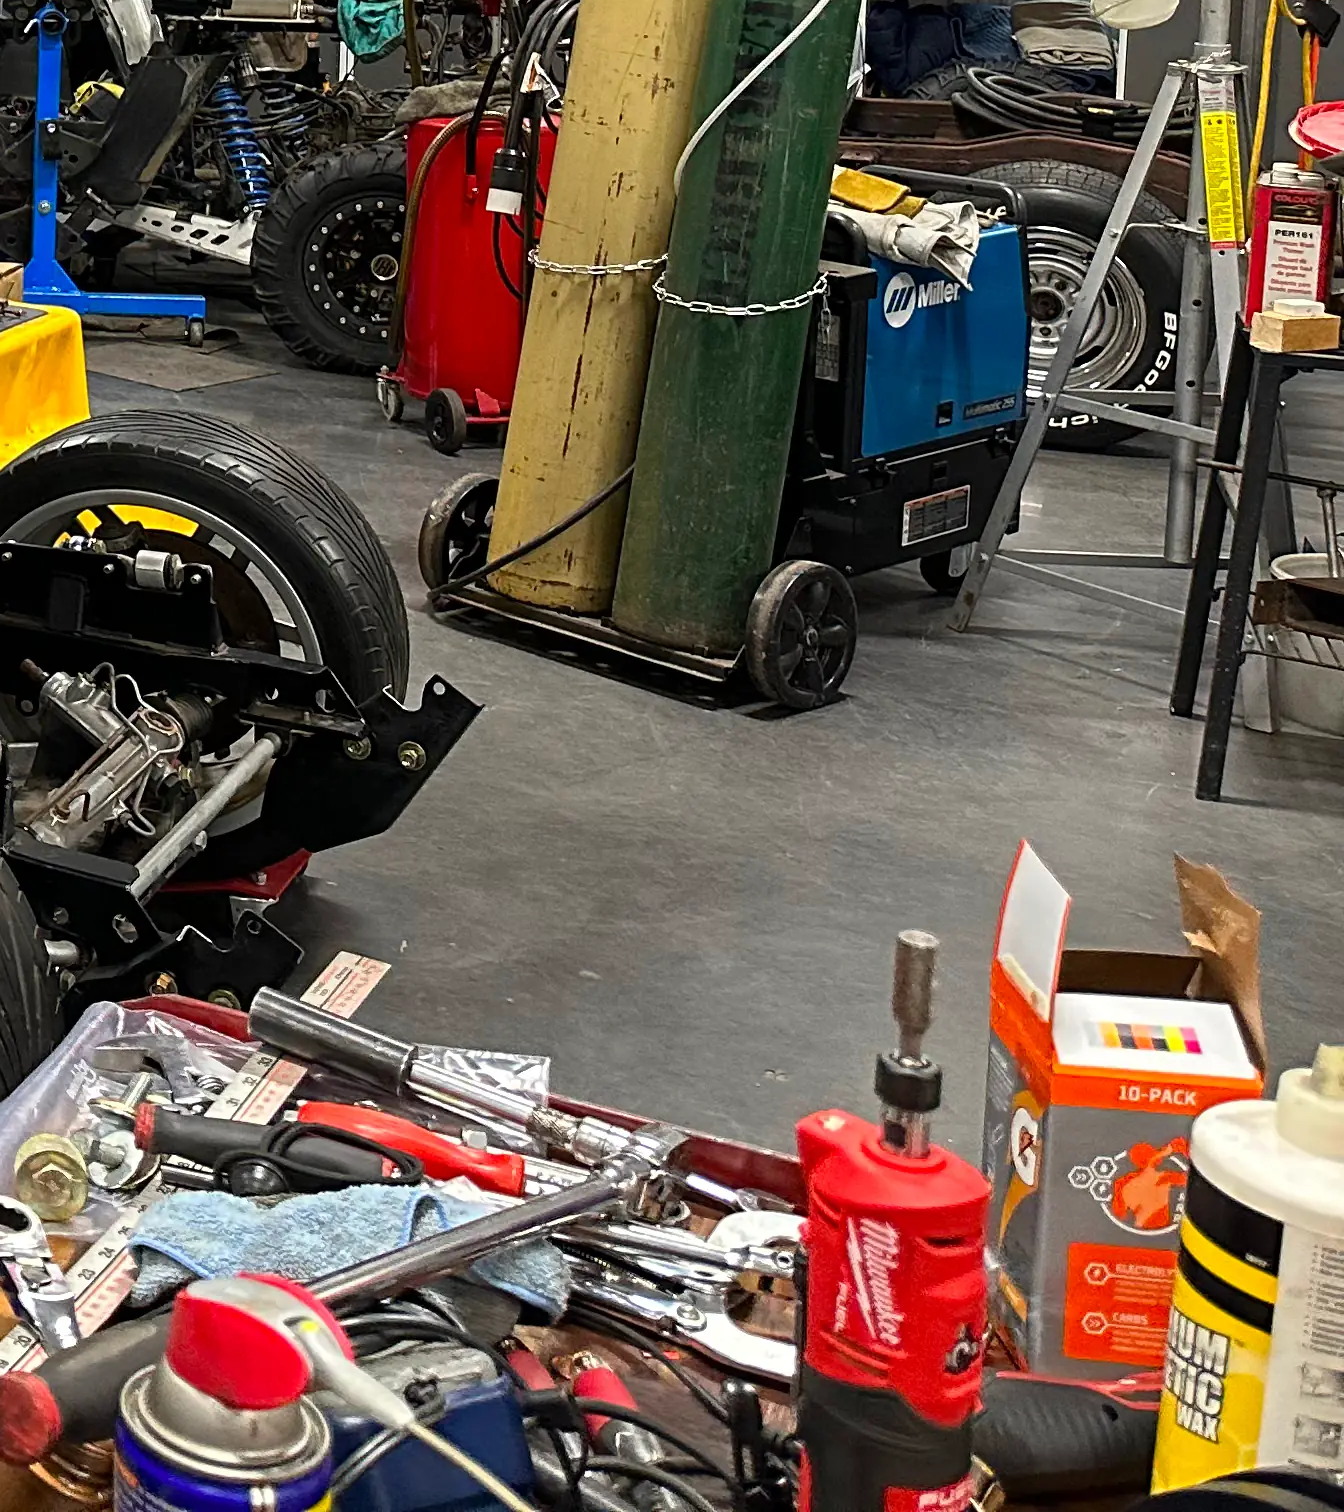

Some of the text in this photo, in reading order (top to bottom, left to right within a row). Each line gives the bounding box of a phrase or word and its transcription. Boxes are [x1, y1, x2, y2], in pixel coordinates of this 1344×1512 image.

[917, 278, 961, 309] Miller
[1118, 1085, 1198, 1106] 10-PACK
[98, 1246, 116, 1260] 24
[78, 1267, 96, 1282] 23
[860, 1216, 905, 1346] Milwaukee
[14, 1335, 33, 1349] 20
[1176, 1401, 1221, 1445] WAX
